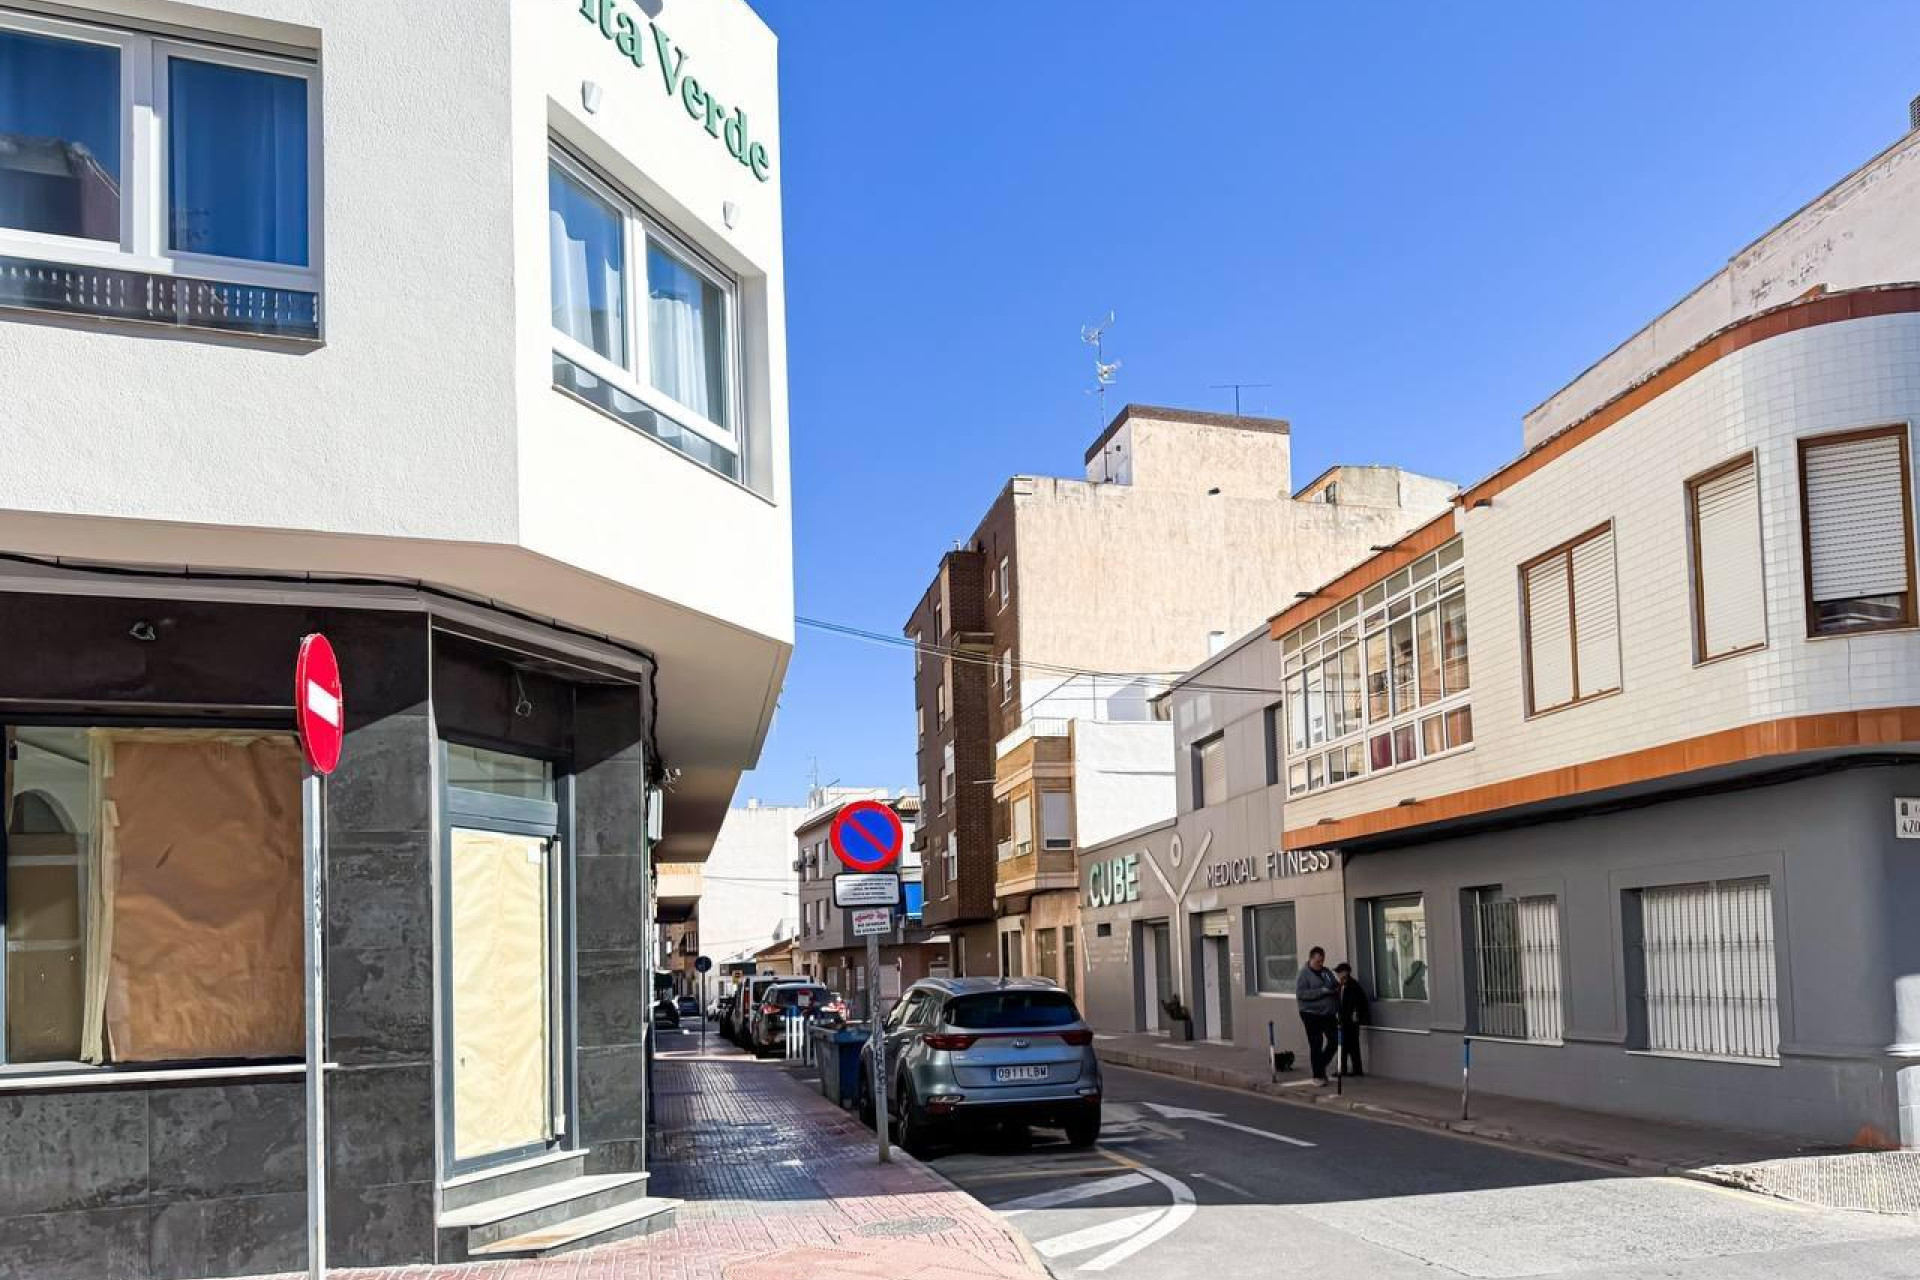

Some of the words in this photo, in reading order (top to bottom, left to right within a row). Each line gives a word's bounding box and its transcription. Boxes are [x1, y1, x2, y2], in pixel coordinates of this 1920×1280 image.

[649, 21, 769, 183] Verde
[1089, 853, 1140, 908] CUBE
[1206, 855, 1258, 888] MEDICAL
[1265, 849, 1332, 880] FITNESS
